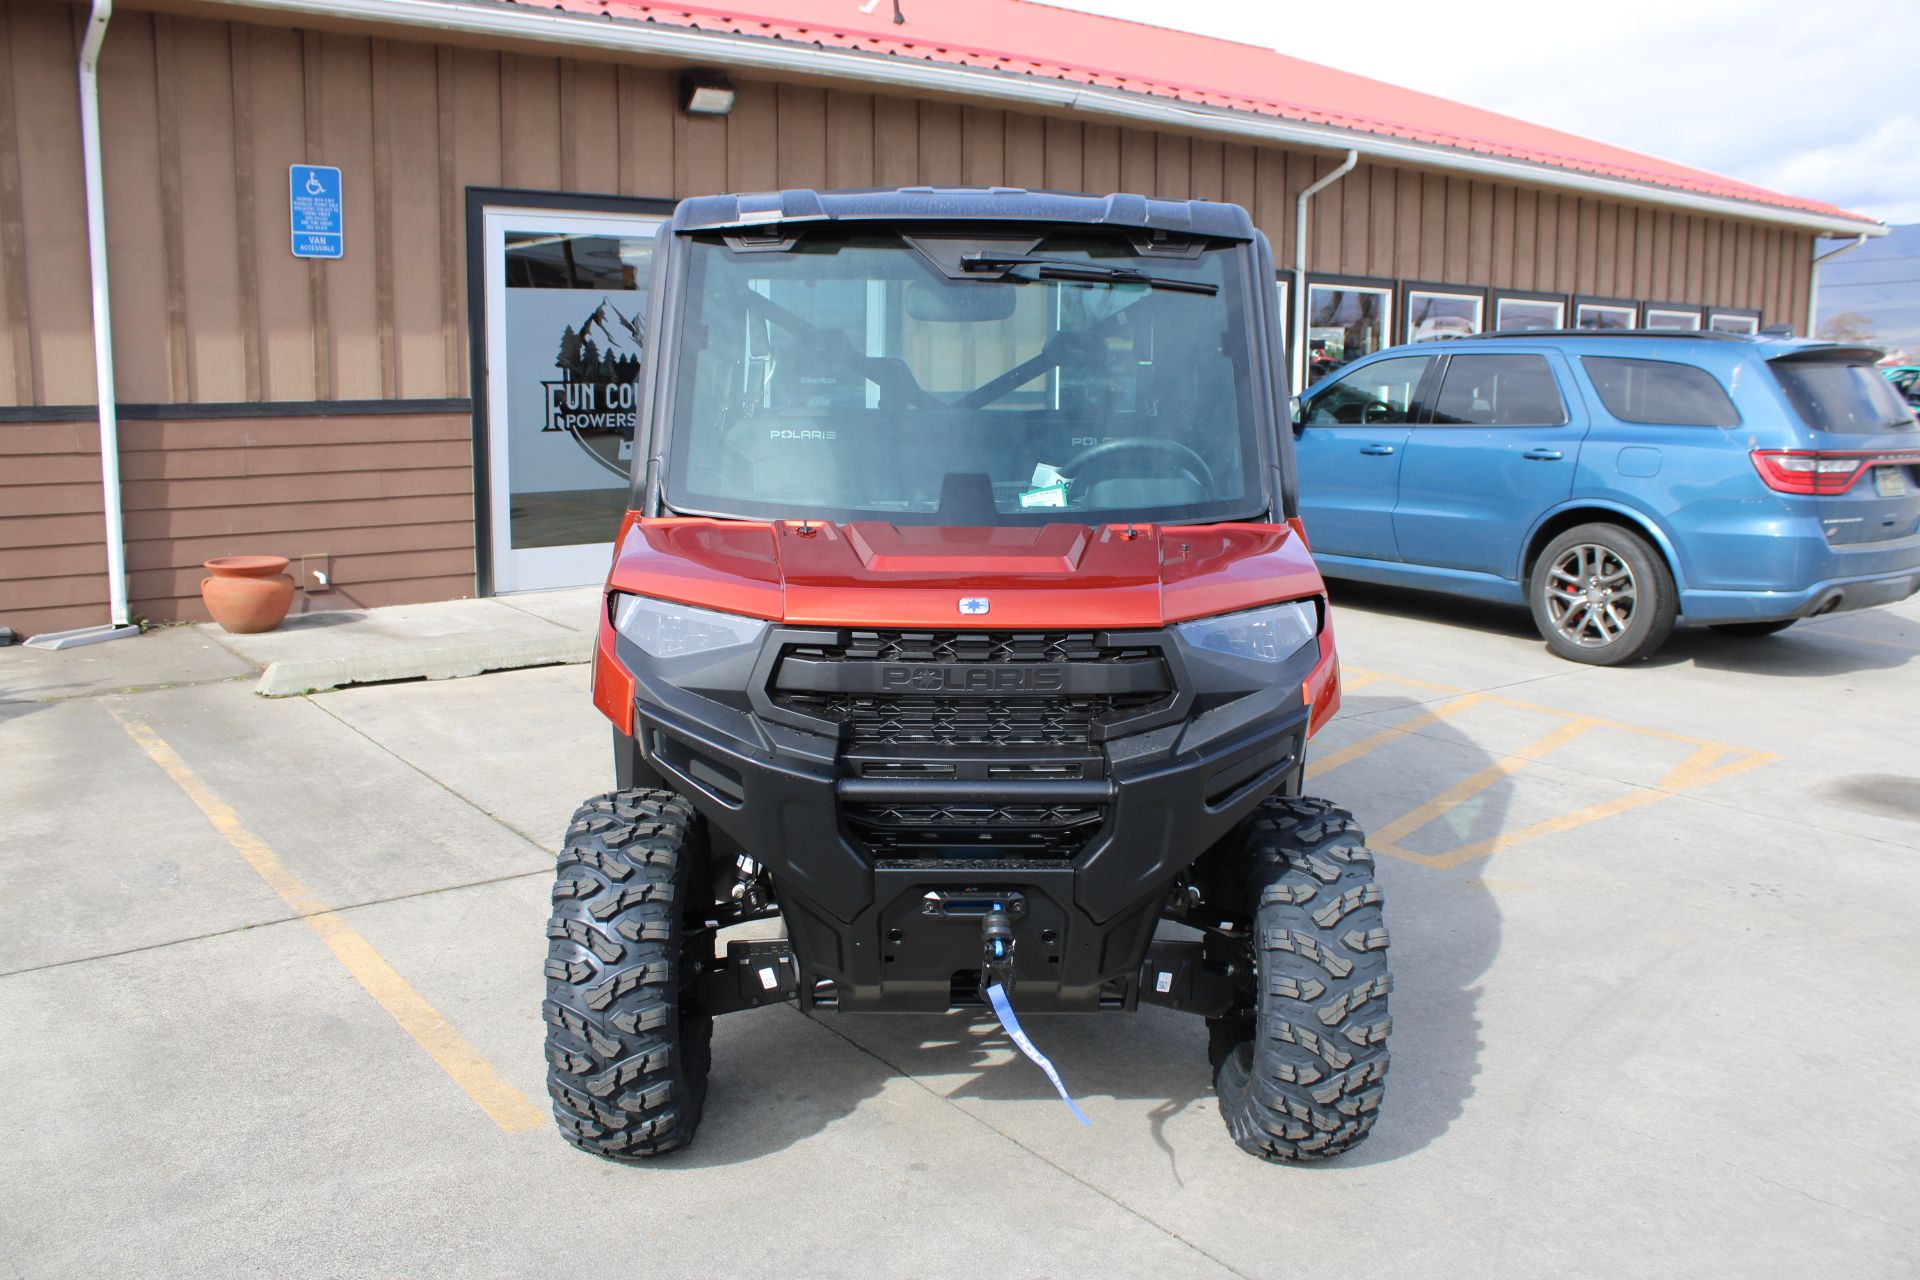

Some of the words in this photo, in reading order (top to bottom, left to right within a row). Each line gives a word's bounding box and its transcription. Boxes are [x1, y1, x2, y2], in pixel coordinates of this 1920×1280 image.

[308, 235, 326, 244] VAN
[299, 244, 335, 252] ACCESSIBLE
[541, 381, 596, 432] FUN
[770, 430, 837, 439] POLARIS
[883, 667, 1063, 691] POLARIS
